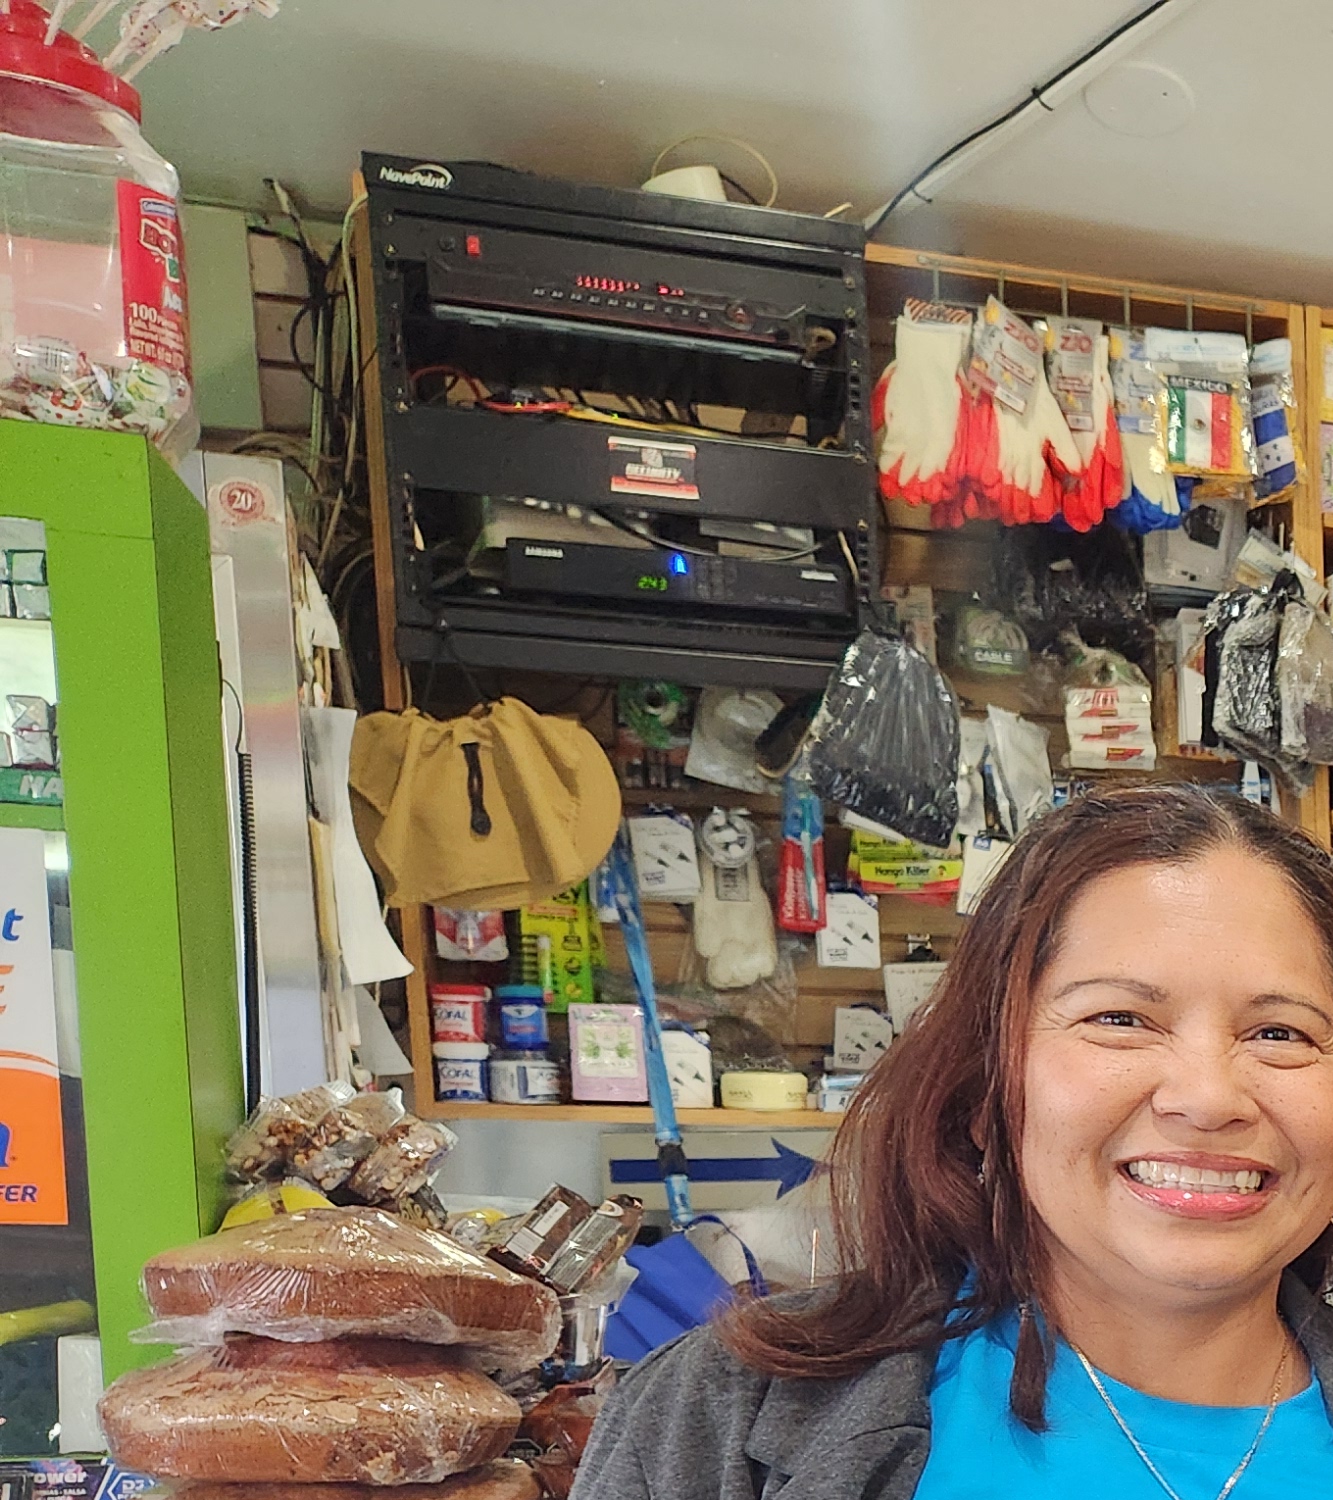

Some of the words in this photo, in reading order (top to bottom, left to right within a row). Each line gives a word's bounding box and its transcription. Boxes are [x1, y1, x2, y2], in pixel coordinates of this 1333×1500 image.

[380, 165, 450, 190] NavePoint
[129, 302, 157, 323] 100
[1170, 374, 1228, 392] MEXICO
[233, 490, 252, 511] 20
